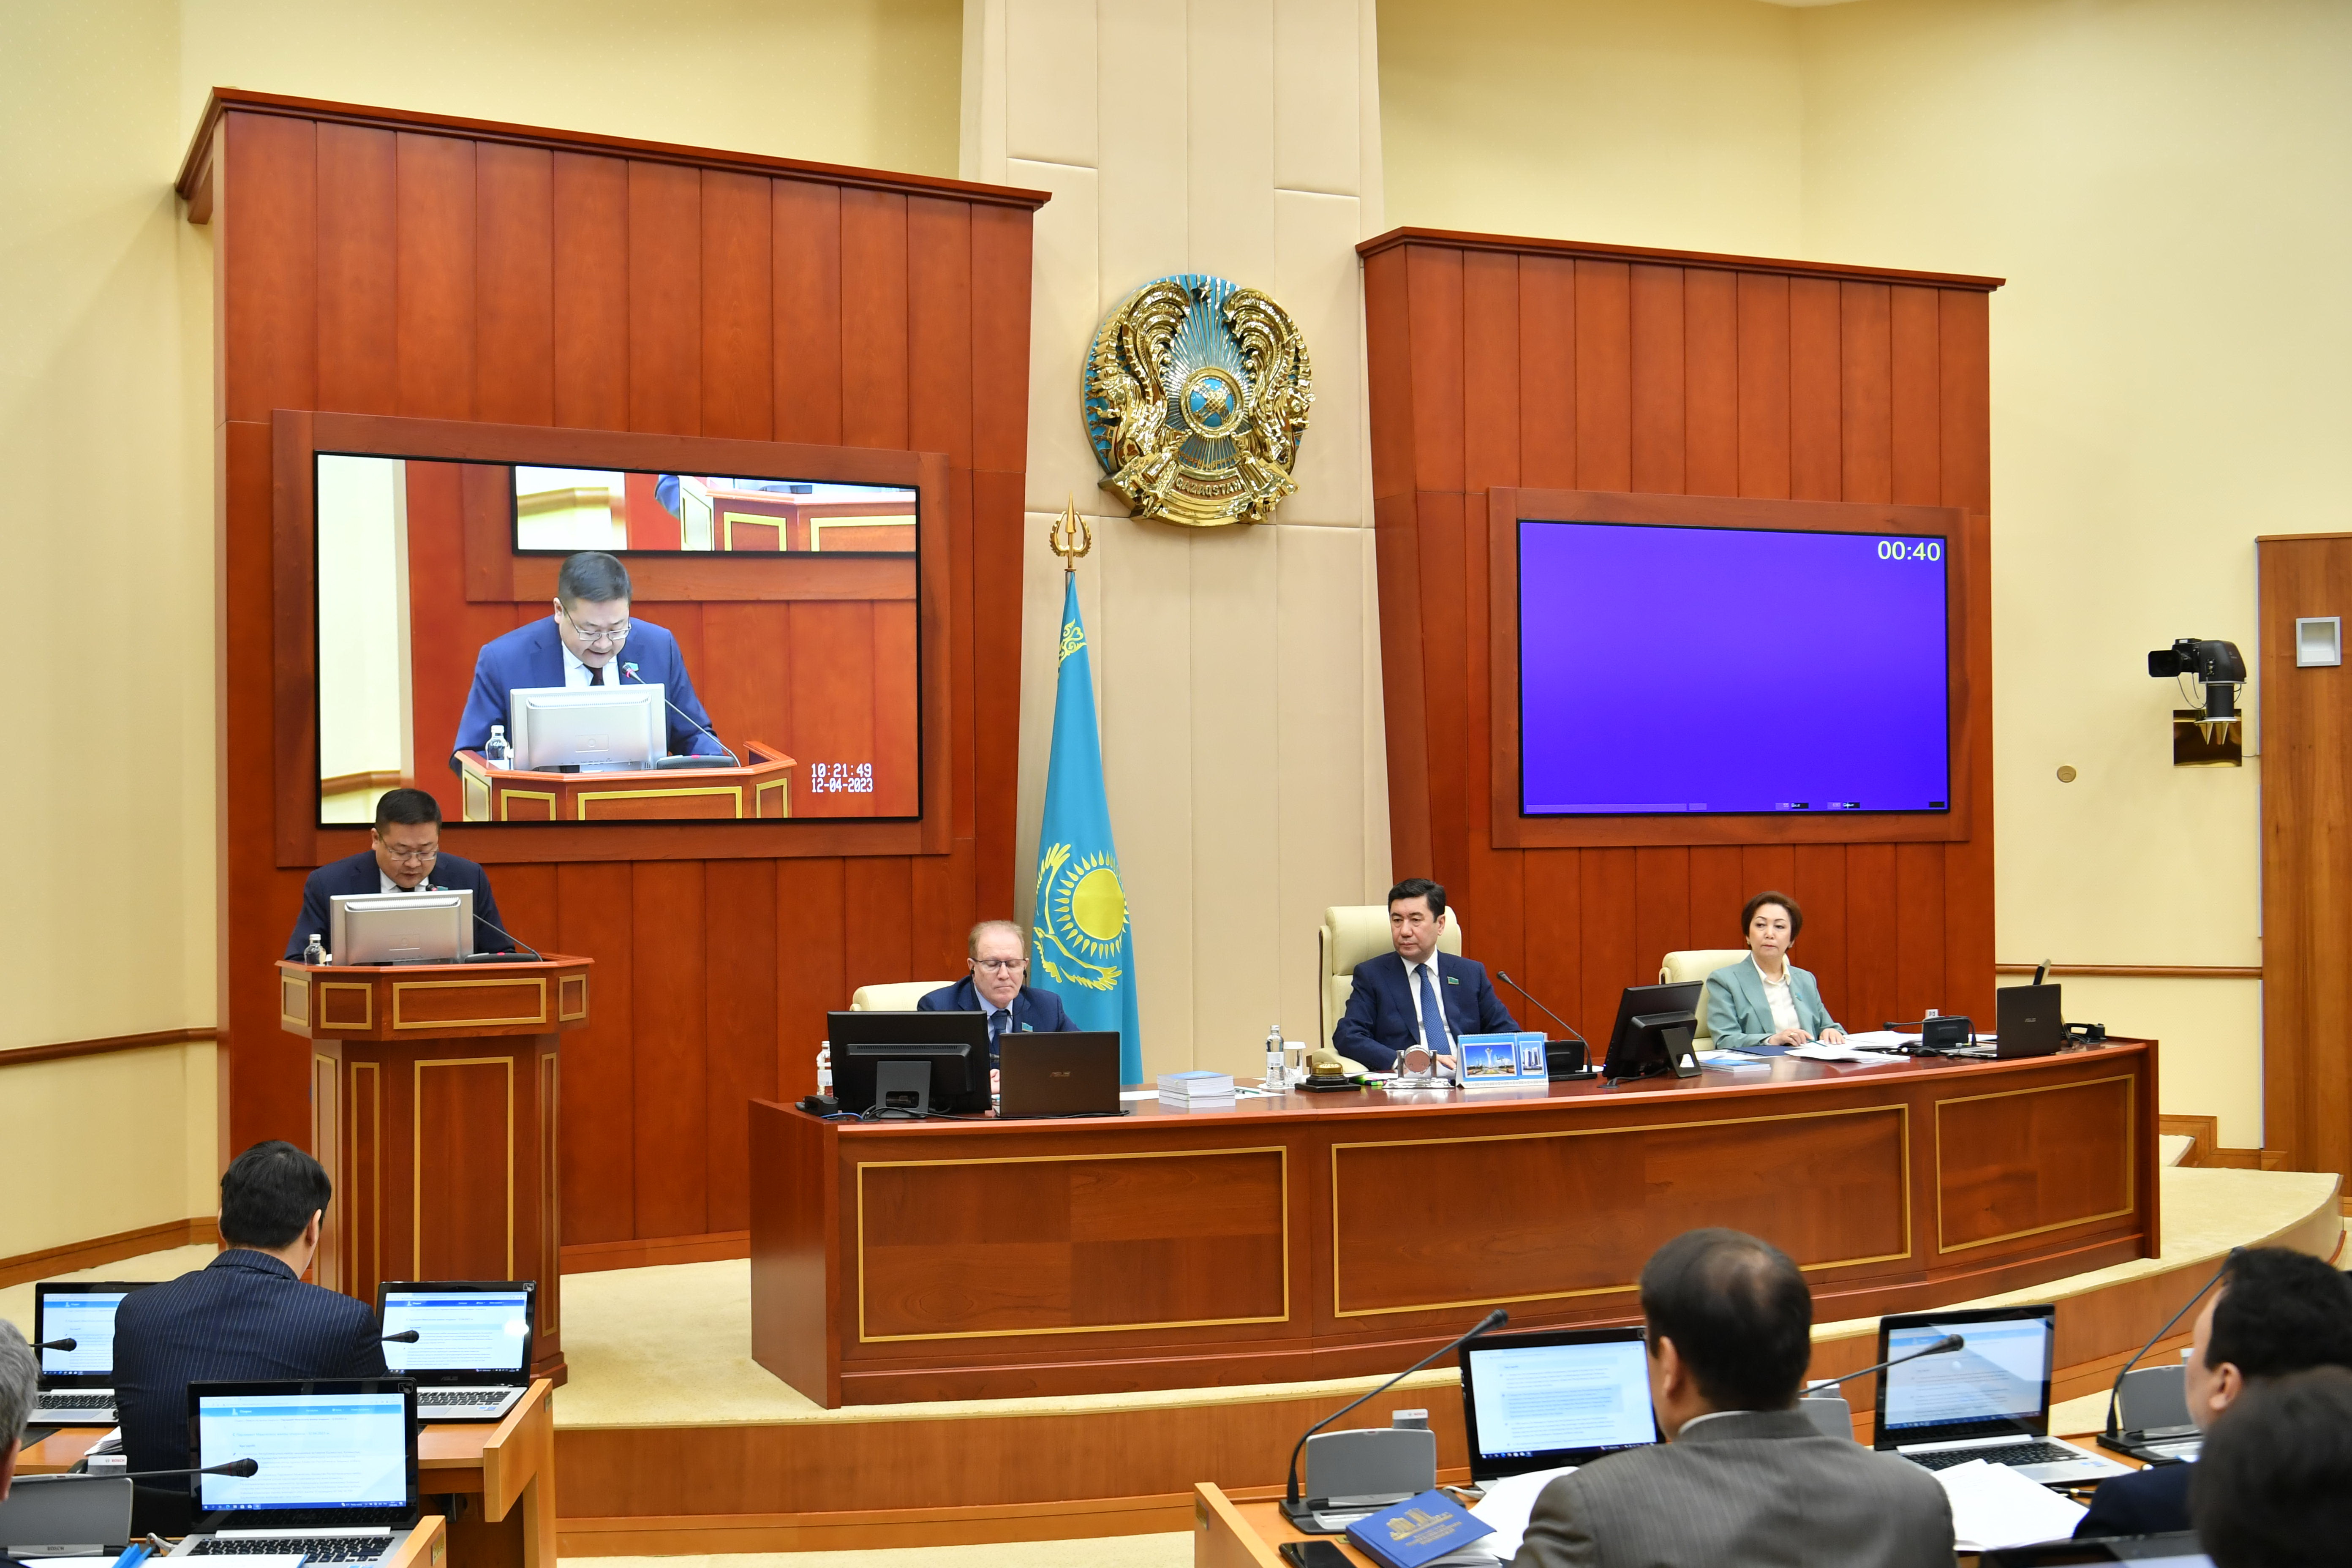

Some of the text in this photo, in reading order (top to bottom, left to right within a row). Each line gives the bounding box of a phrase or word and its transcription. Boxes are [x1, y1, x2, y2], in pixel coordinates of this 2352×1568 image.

[1176, 477, 1242, 497] QAZAQSTAN
[1878, 540, 1941, 561] 00:40
[811, 762, 872, 778] 10:21:49
[811, 777, 873, 793] 12-04-2023
